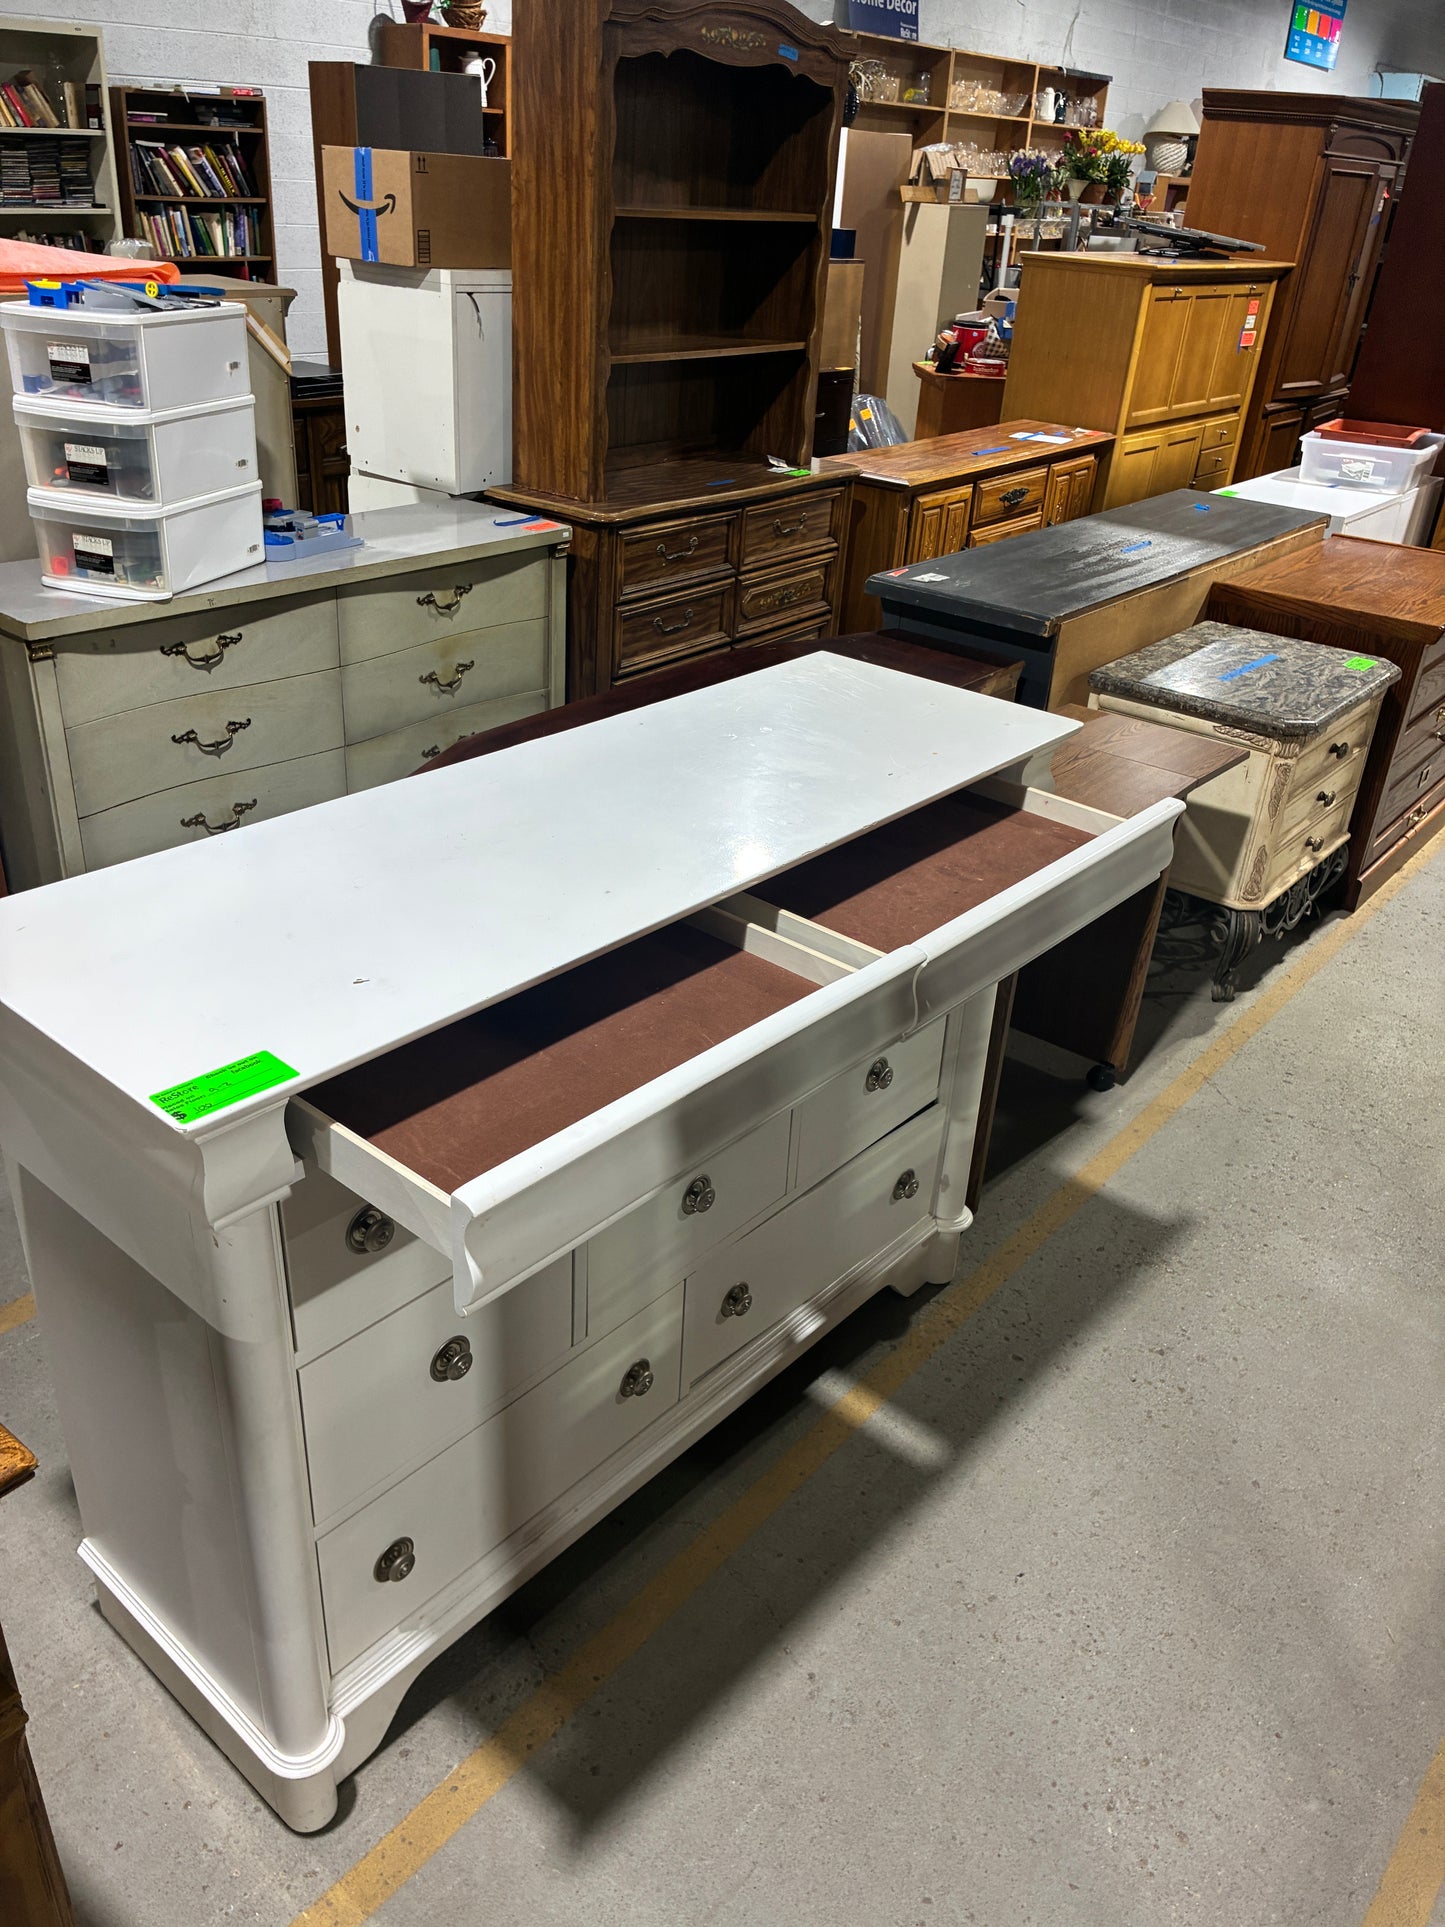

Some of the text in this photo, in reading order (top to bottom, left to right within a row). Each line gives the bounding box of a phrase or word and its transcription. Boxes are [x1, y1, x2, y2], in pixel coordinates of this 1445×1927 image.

[851, 0, 884, 8] me
[900, 27, 917, 40] ReStre
[230, 1059, 262, 1075] facebook
[157, 1084, 199, 1104] ReStore
[171, 1110, 188, 1121] $
